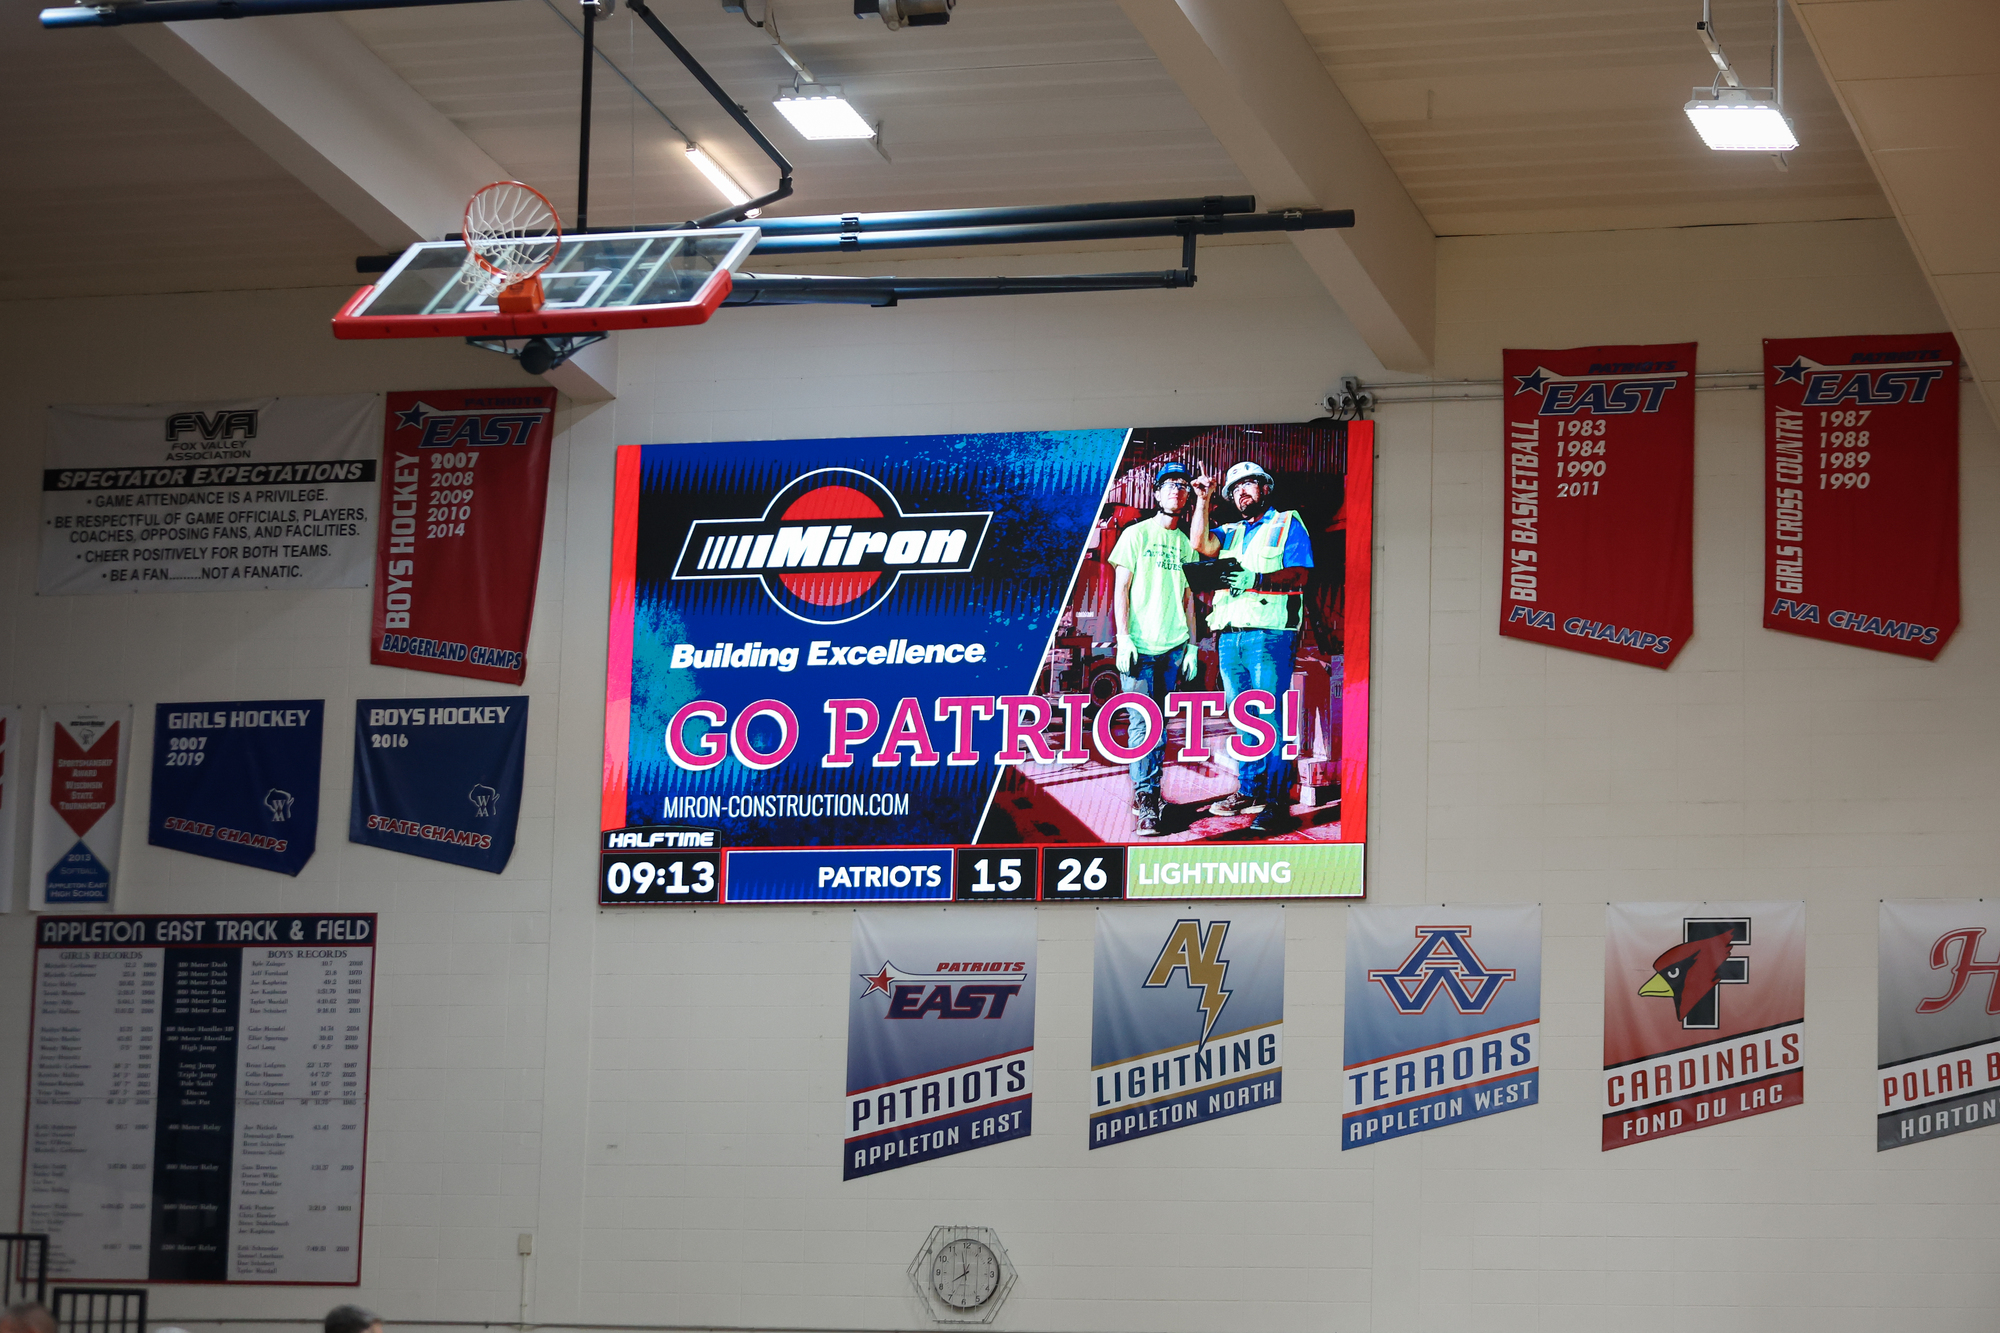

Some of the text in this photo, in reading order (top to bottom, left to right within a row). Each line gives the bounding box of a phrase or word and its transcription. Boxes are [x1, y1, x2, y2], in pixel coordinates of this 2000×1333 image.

[1588, 360, 1678, 374] PATRIOTS
[1850, 350, 1941, 363] PATRIOTS
[1538, 380, 1676, 416] EAST
[1801, 370, 1943, 406] EAST
[166, 410, 257, 441] FVA
[1557, 420, 1606, 437] 1983
[1820, 410, 1871, 428] 1987
[418, 416, 543, 448] EAST
[1820, 431, 1870, 448] 1988
[166, 450, 250, 461] ASSOCIATION
[172, 441, 247, 450] FOX VALLEY
[1557, 440, 1606, 457] 1984
[431, 452, 480, 469] 2007
[1557, 460, 1606, 478] 1990
[1820, 451, 1870, 468] 1989
[58, 463, 363, 488] SPECTATOR EXPECTATIONS
[430, 472, 474, 487] 2008
[1820, 472, 1870, 490] 1990
[96, 489, 328, 507] GAME ATTENDANCE IS A PRIVILEGE.
[429, 490, 474, 505] 2009
[1556, 481, 1600, 498] 2011
[1776, 406, 1803, 594] GIRLS CROSS COUNTRY
[54, 508, 368, 528] BE RESPECTFUL OF GAME OFFICIALS, PLAYERS,
[427, 506, 471, 522] 2010
[1510, 418, 1540, 602] BOYS BASKETBALL
[70, 524, 360, 544] COACHES, OPPOSING FANS, AND FACILITIES.
[386, 451, 420, 628] BOYS HOCKEY
[426, 523, 465, 539] 2014
[85, 544, 331, 562] CHEER POSITIVELY FOR BOTH TEAMS.
[766, 525, 968, 568] Miron
[110, 570, 127, 582] BE
[130, 570, 140, 581] A
[230, 566, 240, 578] A
[244, 565, 302, 578] FANATIC.
[1508, 605, 1672, 654] FVA CHAMPS
[1772, 598, 1940, 645] FVA CHAMPS
[381, 633, 522, 670] BADGERLAND CHAMPS
[670, 642, 799, 672] Building
[168, 710, 310, 729] GIRLS HOCKEY
[370, 706, 510, 726] BOYS HOCKEY
[371, 734, 409, 748] 2016
[666, 690, 1301, 772] GO PATRIOTS!
[170, 737, 208, 750] 2007
[166, 752, 205, 766] 2019
[663, 793, 909, 818] MIRON-CONSTRUCTION.COM
[164, 816, 288, 852] STATE CHAMPS
[367, 815, 492, 849] STATE CHAMPS
[608, 832, 714, 848] HALFTIME
[68, 854, 92, 862] 2013
[606, 861, 716, 894] 09:13
[818, 866, 942, 888] PATRIOTS
[971, 858, 1022, 892] 15
[1056, 858, 1108, 892] 26
[1138, 862, 1292, 885] LIGHTNING
[43, 920, 370, 942] APPLETON EAST TRACK & FIELD
[60, 951, 144, 960] GIRLS RECORDS
[268, 950, 348, 958] BOYS RECORDS
[936, 961, 1026, 972] PATRIOTS
[884, 984, 1023, 1020] EAST
[1096, 1032, 1276, 1106] LIGHTNING
[1349, 1032, 1530, 1106] TERRORS
[1608, 1033, 1800, 1106] CARDINALS
[1883, 1059, 1972, 1106] POLAR
[852, 1059, 1026, 1132] PATRIOTS
[1096, 1079, 1276, 1142] APPLETON NORTH
[1350, 1080, 1532, 1142] APPLETON WEST
[1623, 1084, 1782, 1140] FOND DU LAC
[1901, 1099, 2000, 1139] HORTON
[854, 1110, 1022, 1169] APPLETON EAST
